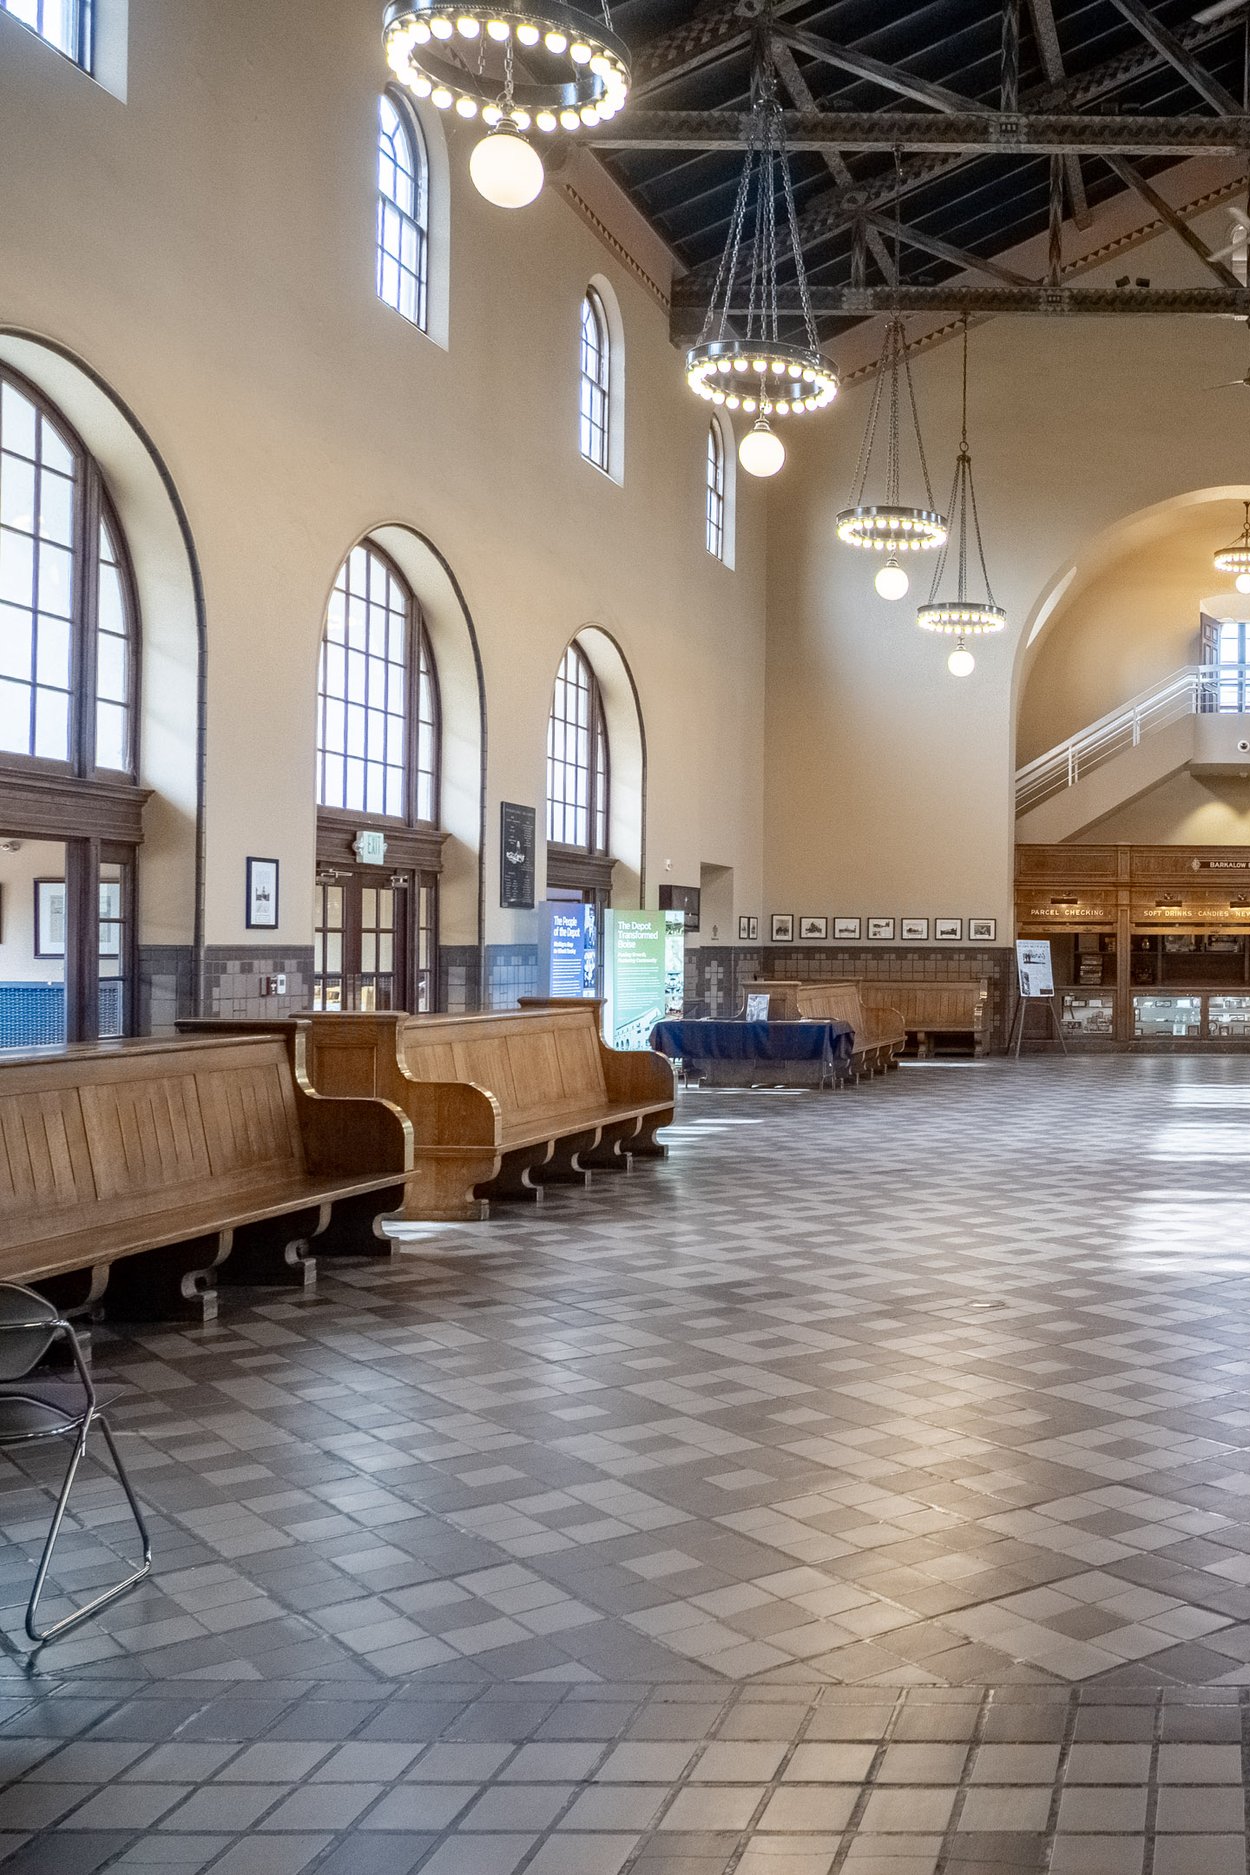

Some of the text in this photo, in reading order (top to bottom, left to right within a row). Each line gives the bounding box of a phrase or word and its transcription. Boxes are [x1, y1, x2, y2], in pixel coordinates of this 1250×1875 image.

[553, 915, 578, 928] The People
[617, 921, 652, 931] The Depot
[553, 926, 581, 939] of the Depot
[617, 930, 659, 940] Transformed
[617, 939, 637, 949] Boise
